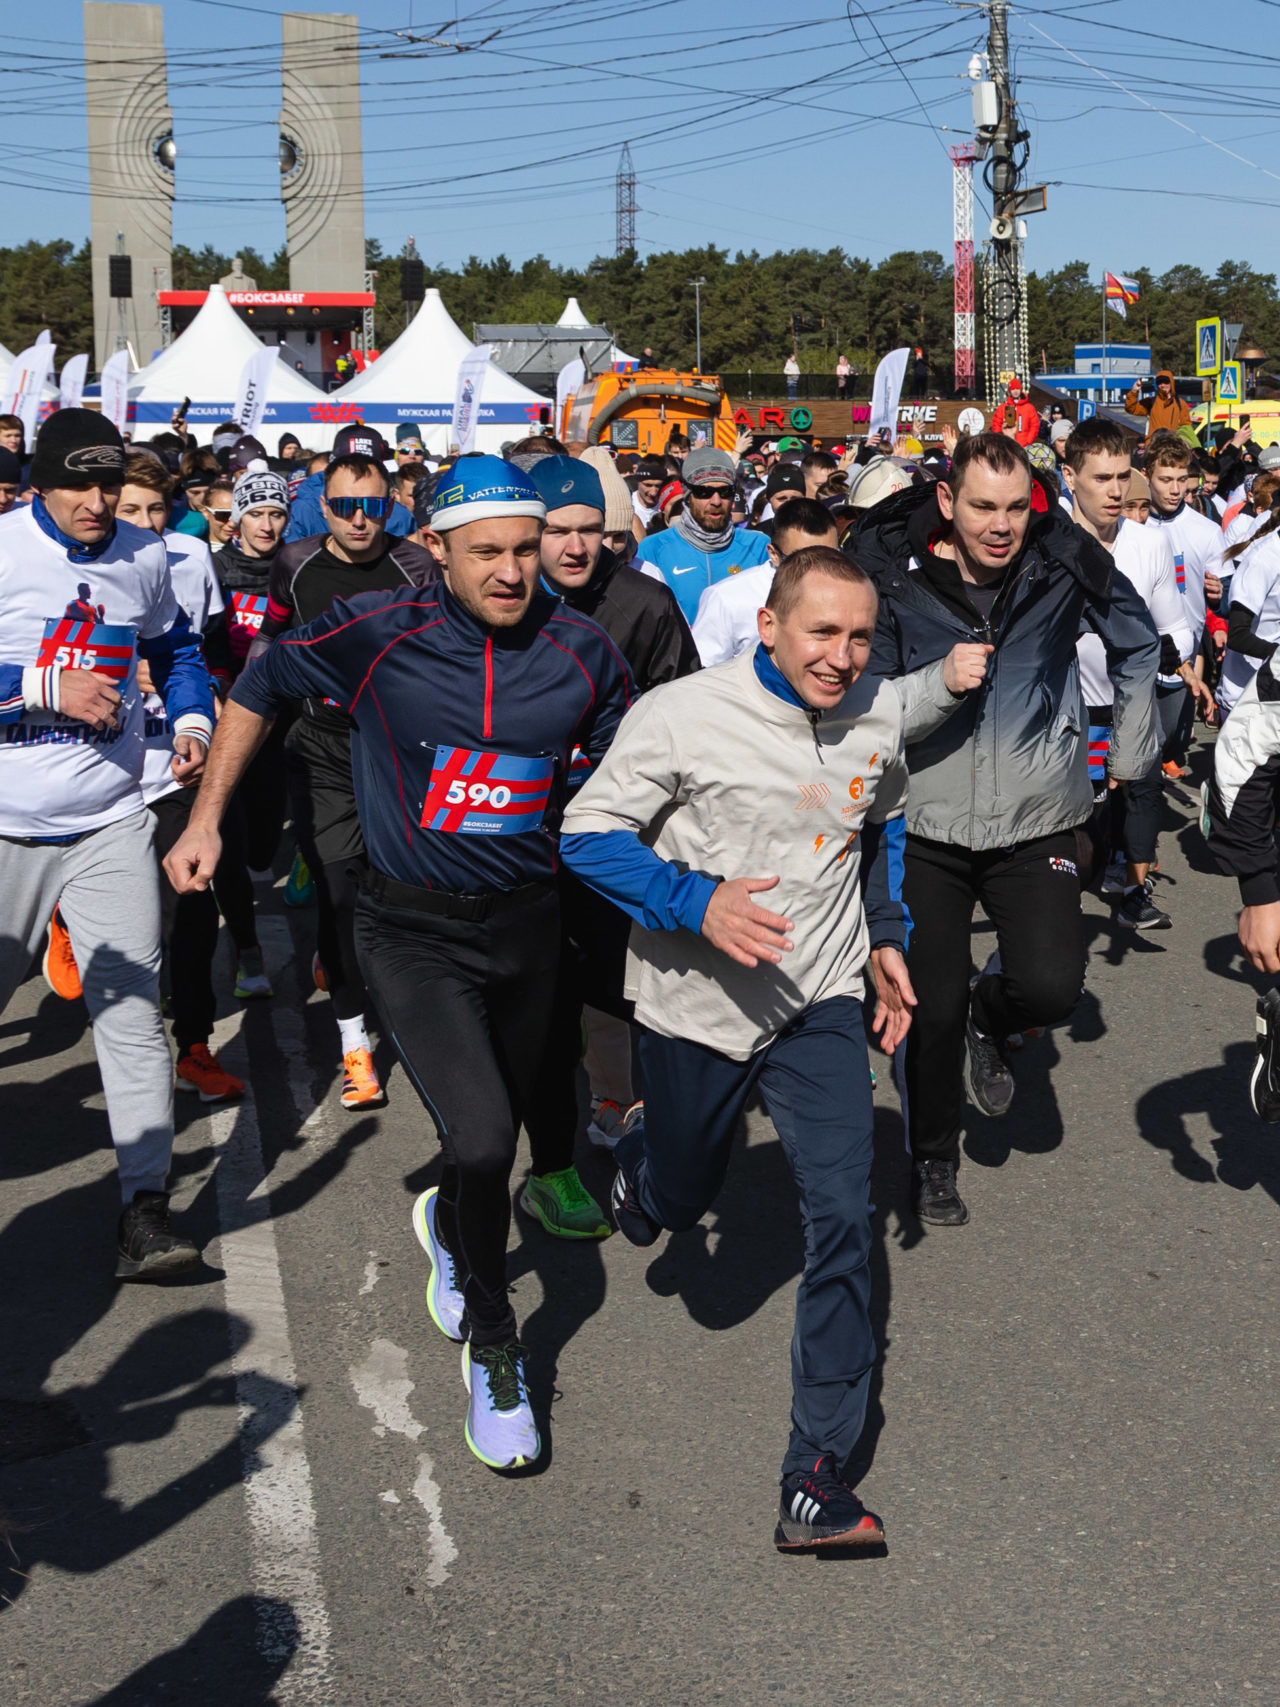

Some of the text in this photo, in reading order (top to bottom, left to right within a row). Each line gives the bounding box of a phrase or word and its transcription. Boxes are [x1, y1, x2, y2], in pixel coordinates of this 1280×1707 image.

[229, 293, 305, 304] #БОКСЗАБЕГ
[240, 379, 257, 428] TRIOT
[397, 408, 440, 417] МУЖСКАЯ
[734, 407, 786, 428] AR
[53, 647, 97, 670] 515
[445, 780, 511, 809] 590
